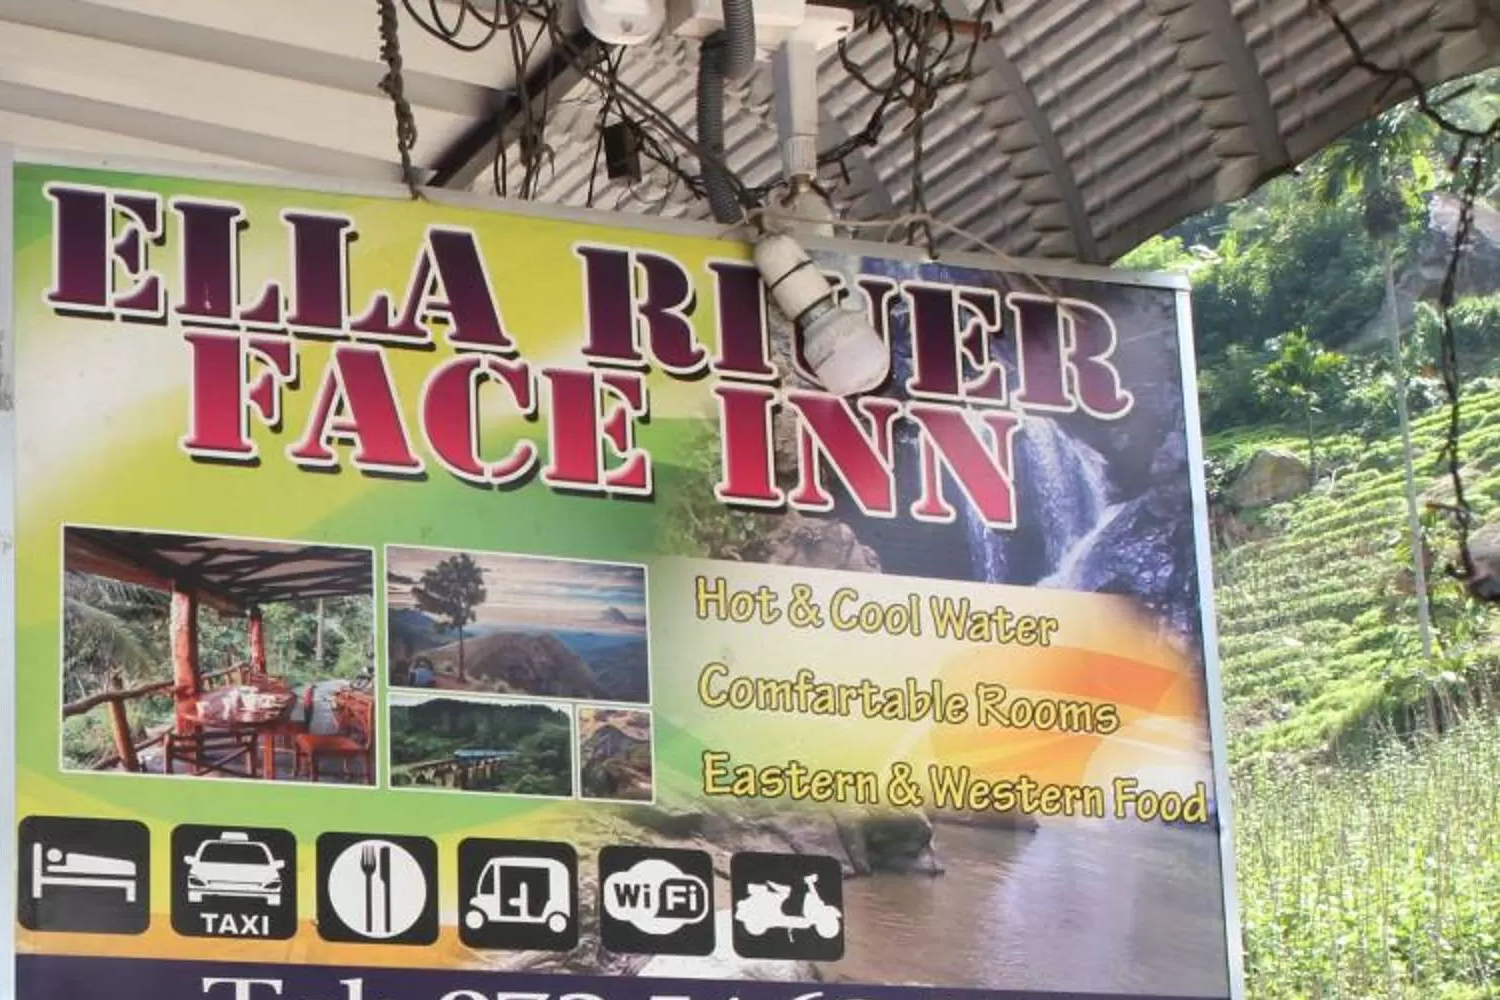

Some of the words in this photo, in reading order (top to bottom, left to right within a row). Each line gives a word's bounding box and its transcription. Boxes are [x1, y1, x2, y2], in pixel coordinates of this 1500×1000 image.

[44, 181, 518, 356] ELLA
[181, 331, 653, 495] FACE
[712, 385, 1020, 529] INN
[695, 576, 781, 624] Hot
[788, 584, 823, 629] &
[829, 588, 921, 637] Cool
[930, 597, 1059, 647] Water
[697, 663, 969, 726] Comfartable
[976, 684, 1120, 735] Rooms
[701, 752, 878, 805] Eastern
[887, 763, 922, 807] &
[929, 765, 1103, 818] Western
[1112, 779, 1209, 824] Food
[200, 912, 270, 937] TAXI
